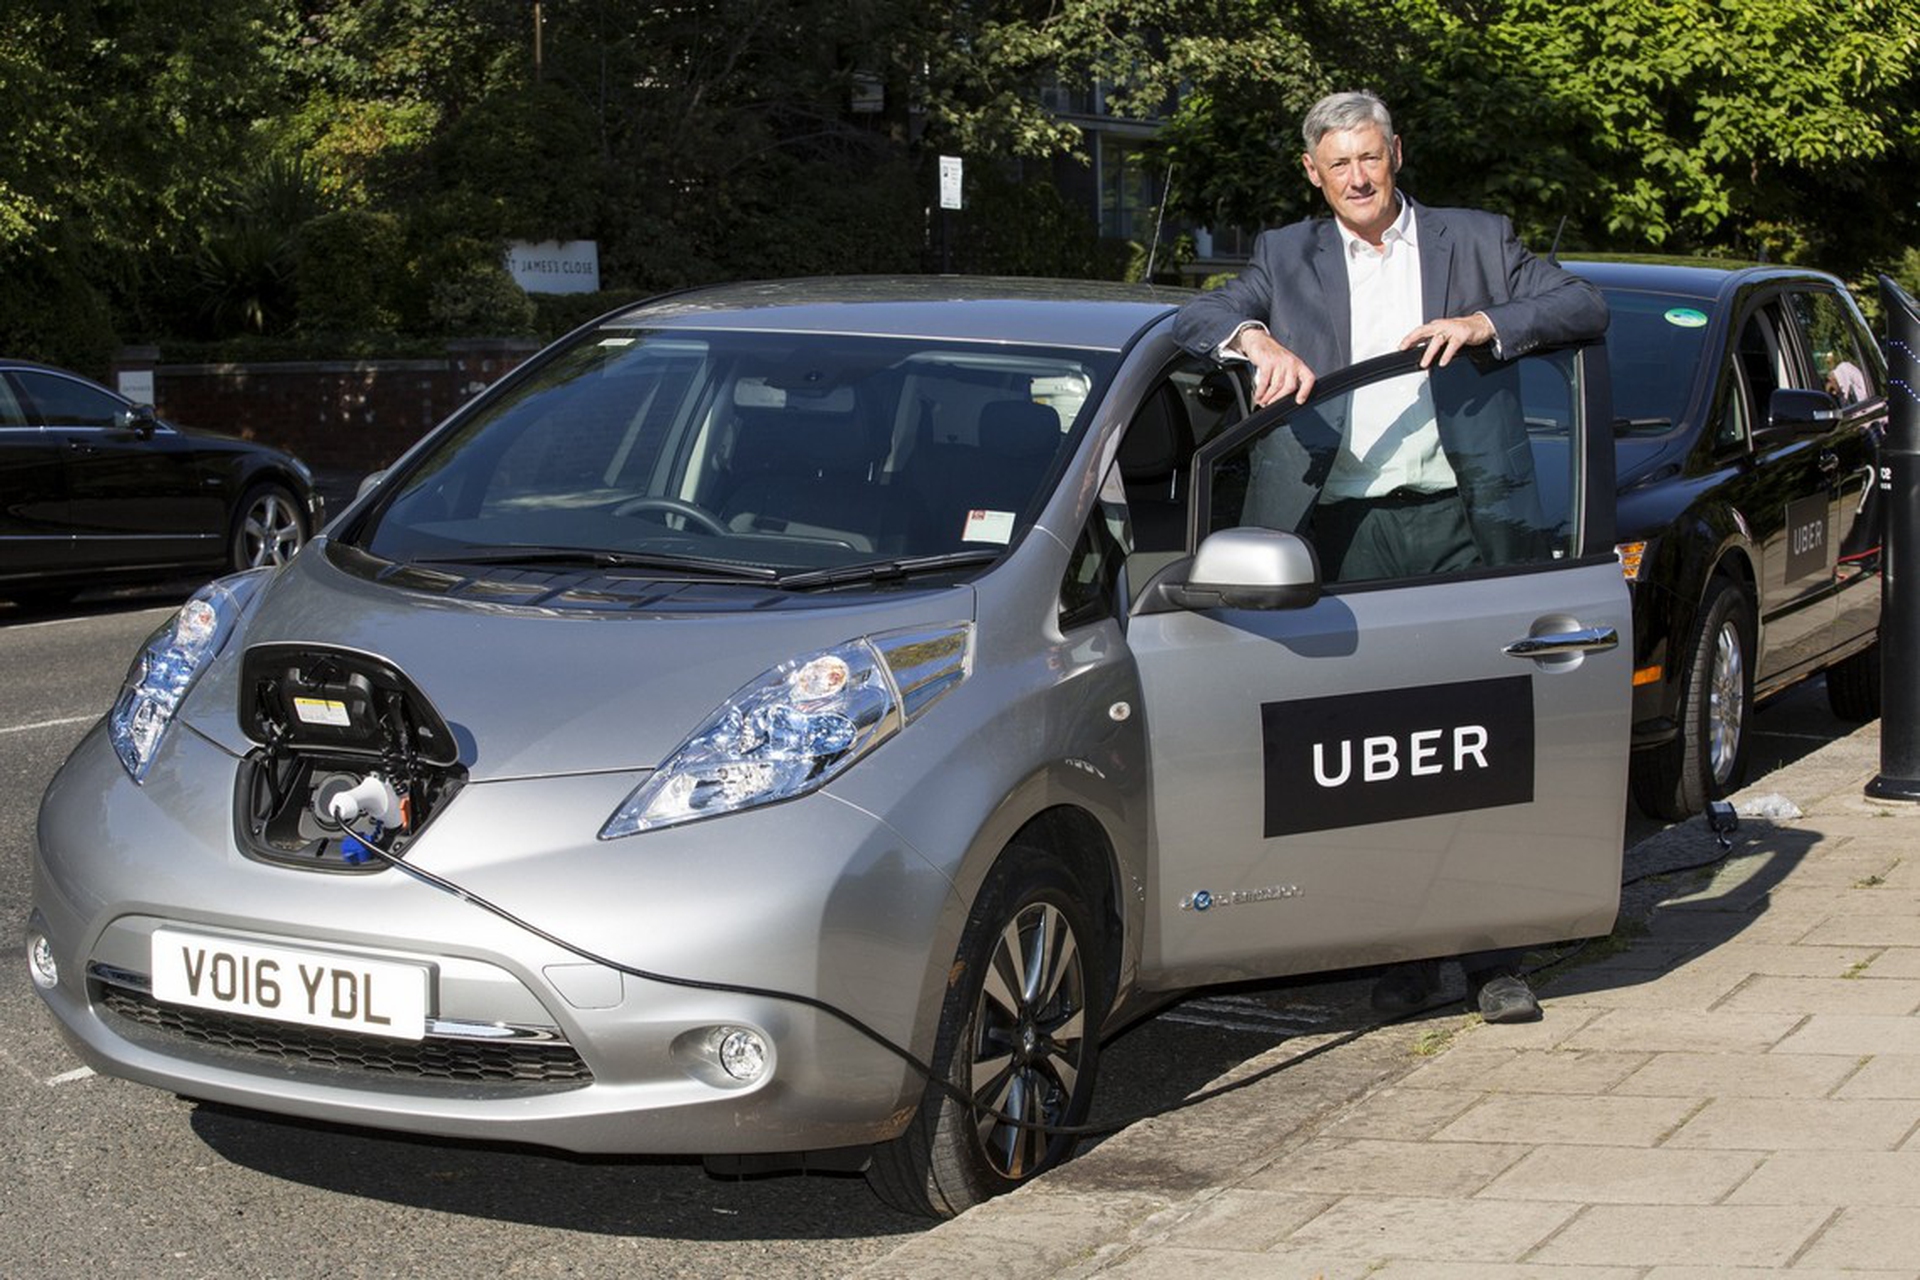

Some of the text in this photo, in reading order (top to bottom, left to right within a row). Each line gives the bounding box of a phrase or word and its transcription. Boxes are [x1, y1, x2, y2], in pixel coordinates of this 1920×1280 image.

[562, 261, 593, 274] CLOSE
[1793, 520, 1823, 555] UBER
[1313, 725, 1489, 788] UBER
[182, 946, 391, 1026] VO16 YDL
